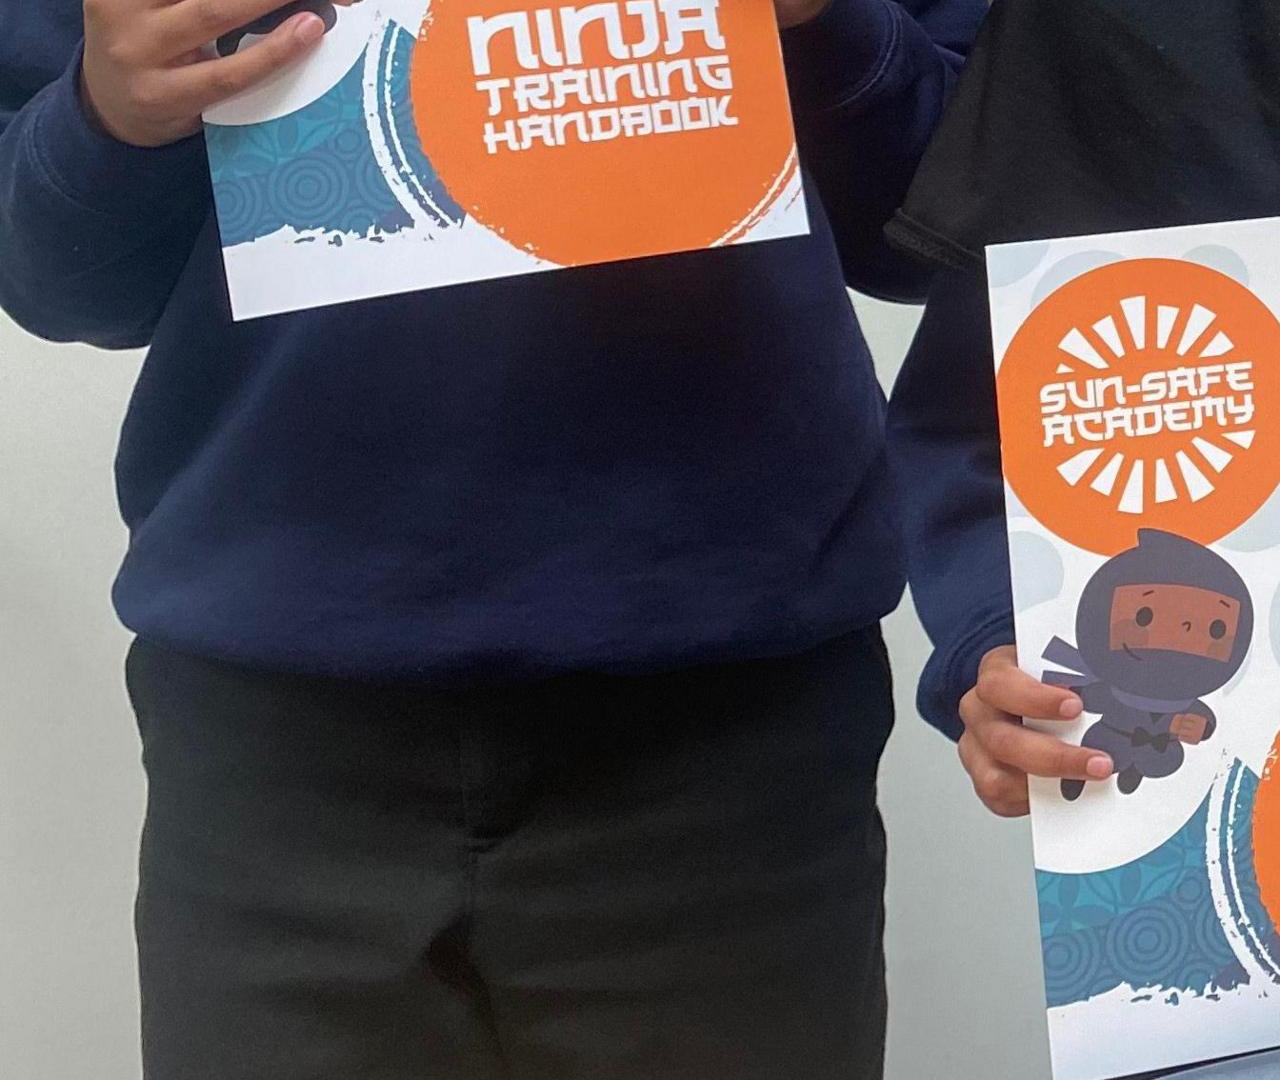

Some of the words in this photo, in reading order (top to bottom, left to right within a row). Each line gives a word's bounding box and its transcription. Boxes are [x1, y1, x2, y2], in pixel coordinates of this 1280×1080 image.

[476, 55, 733, 116] TRAINING
[483, 94, 739, 154] HANDBOOK
[1039, 361, 1254, 415] SUN-SAFE
[1041, 392, 1255, 448] ACADEMY
